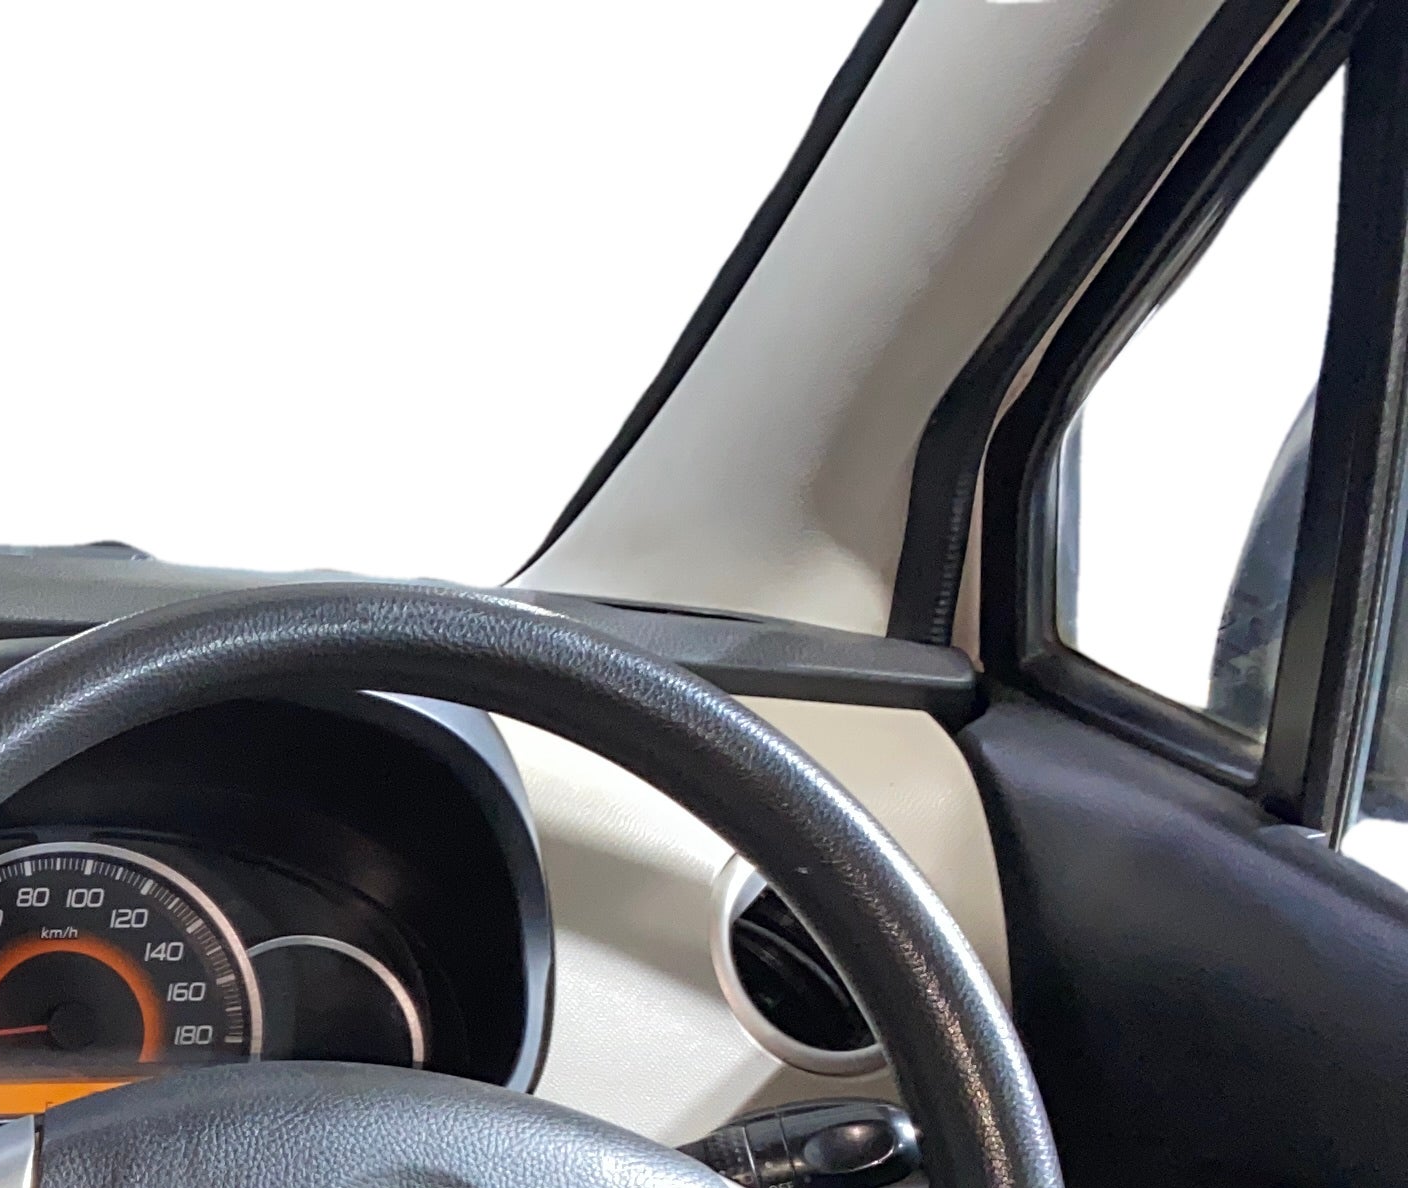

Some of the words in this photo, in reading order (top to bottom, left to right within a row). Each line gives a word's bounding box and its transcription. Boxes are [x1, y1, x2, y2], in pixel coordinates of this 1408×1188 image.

[16, 887, 50, 907] 80
[66, 887, 104, 908] 100
[110, 909, 148, 928] 120
[41, 926, 78, 939] km/h
[144, 942, 183, 961] 140
[167, 982, 205, 1001] 160
[174, 1025, 213, 1045] 180
